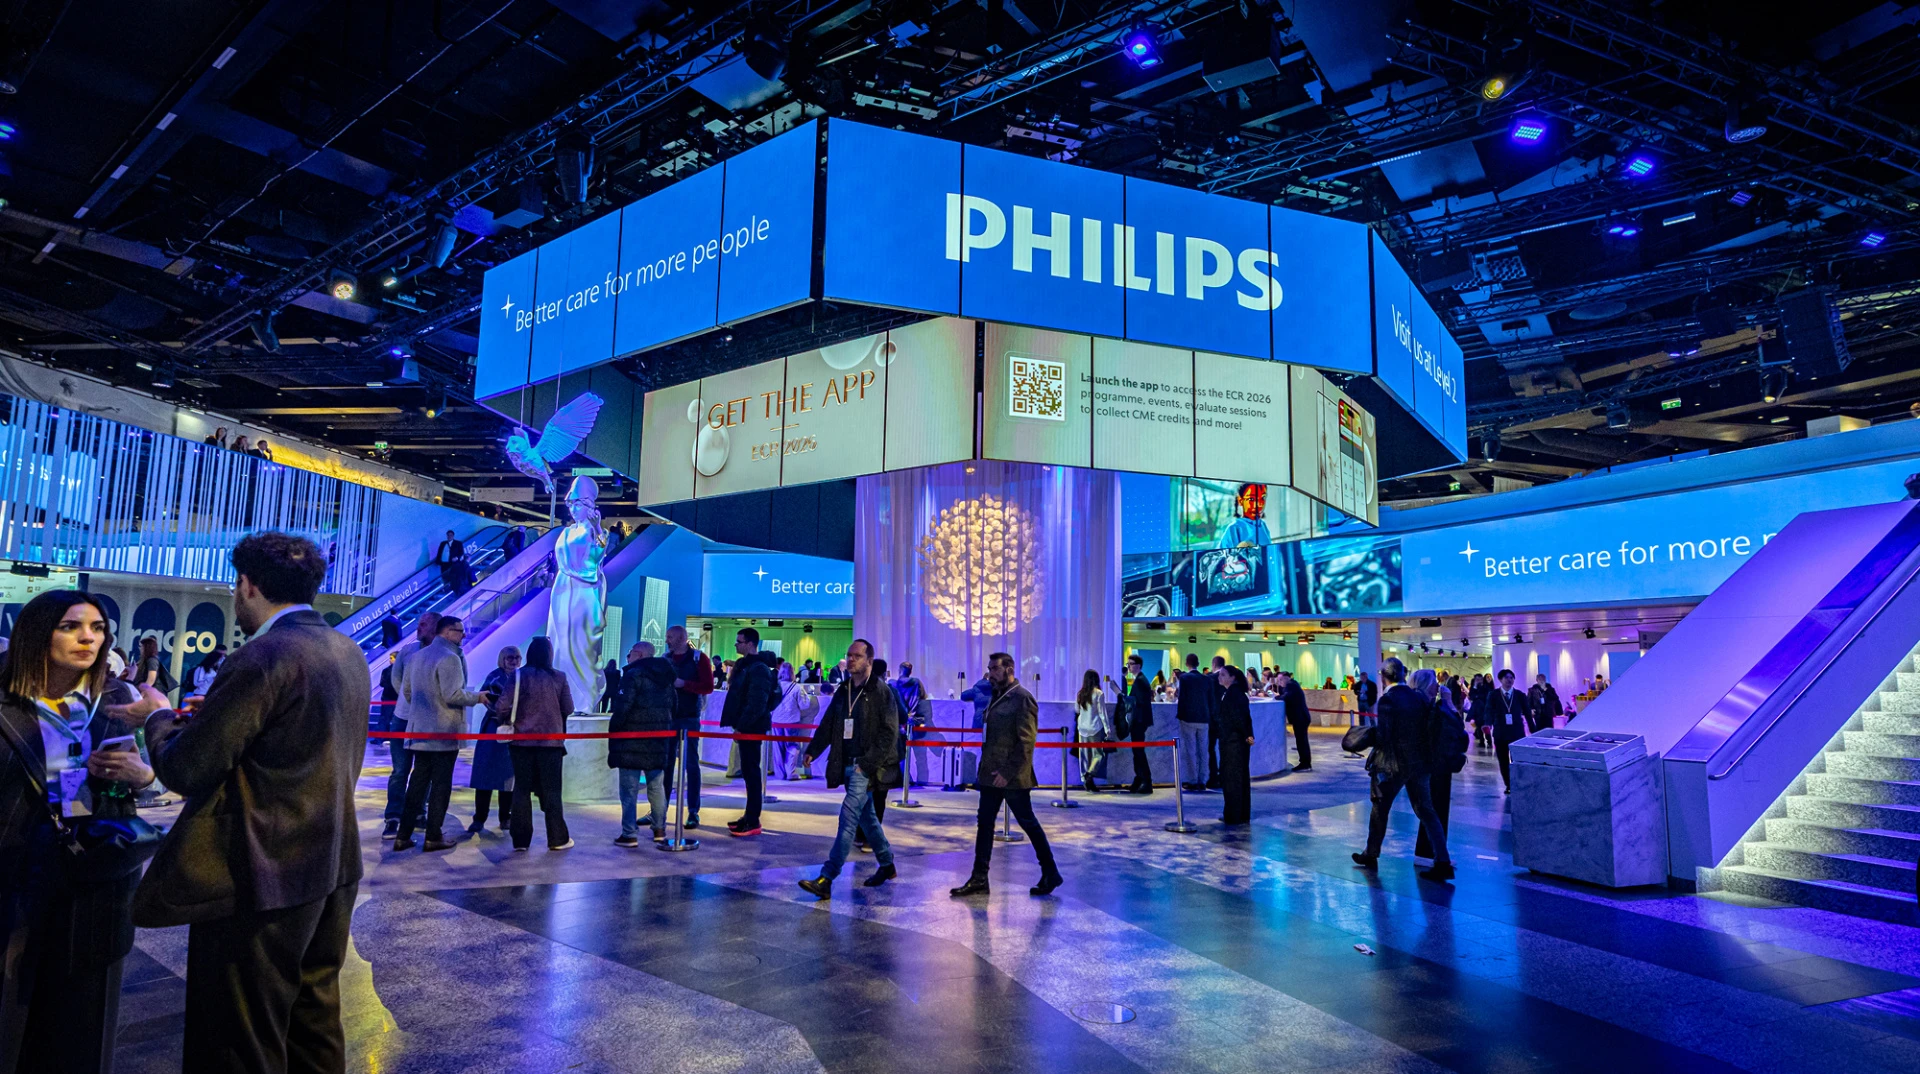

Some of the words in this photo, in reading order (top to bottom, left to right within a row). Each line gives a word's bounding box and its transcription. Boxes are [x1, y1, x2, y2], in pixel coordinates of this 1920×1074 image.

[515, 299, 563, 332] Better
[566, 284, 600, 312] care
[604, 271, 632, 298] for
[636, 251, 686, 286] more
[692, 215, 770, 273] people
[946, 193, 1284, 311] PHILIPS
[1392, 304, 1412, 353] Visit
[1413, 337, 1424, 365] us
[1424, 350, 1432, 377] at
[1433, 354, 1451, 397] Level
[1451, 377, 1457, 404] 2
[707, 396, 752, 431] GET
[760, 383, 813, 420] THE
[822, 369, 875, 408] APP
[1081, 372, 1120, 386] Launch
[1122, 378, 1138, 388] the
[1140, 382, 1159, 393] app
[1160, 383, 1171, 392] to
[1172, 386, 1207, 396] access
[1208, 388, 1223, 399] the
[1225, 390, 1244, 401] ECR
[1247, 393, 1271, 404] 2026
[1081, 389, 1146, 405] programme,
[1148, 396, 1183, 410] events,
[1184, 400, 1228, 414] evaluate
[1229, 406, 1267, 418] sessions
[1080, 404, 1091, 414] to
[1096, 406, 1130, 419] collect
[1132, 409, 1155, 421] CME
[1157, 412, 1190, 425] credits
[1194, 417, 1213, 427] and
[1215, 421, 1242, 430] more!
[751, 441, 779, 461] ECR
[783, 434, 818, 456] 2026
[1484, 555, 1552, 578] Better
[1558, 549, 1611, 571] care
[1618, 540, 1660, 565] for
[1668, 535, 1751, 561] more
[351, 617, 371, 633] Join
[372, 610, 382, 619] us
[383, 600, 392, 612] at
[393, 585, 413, 606] level
[413, 581, 420, 591] 2
[771, 578, 821, 594] Better
[824, 582, 855, 594] care
